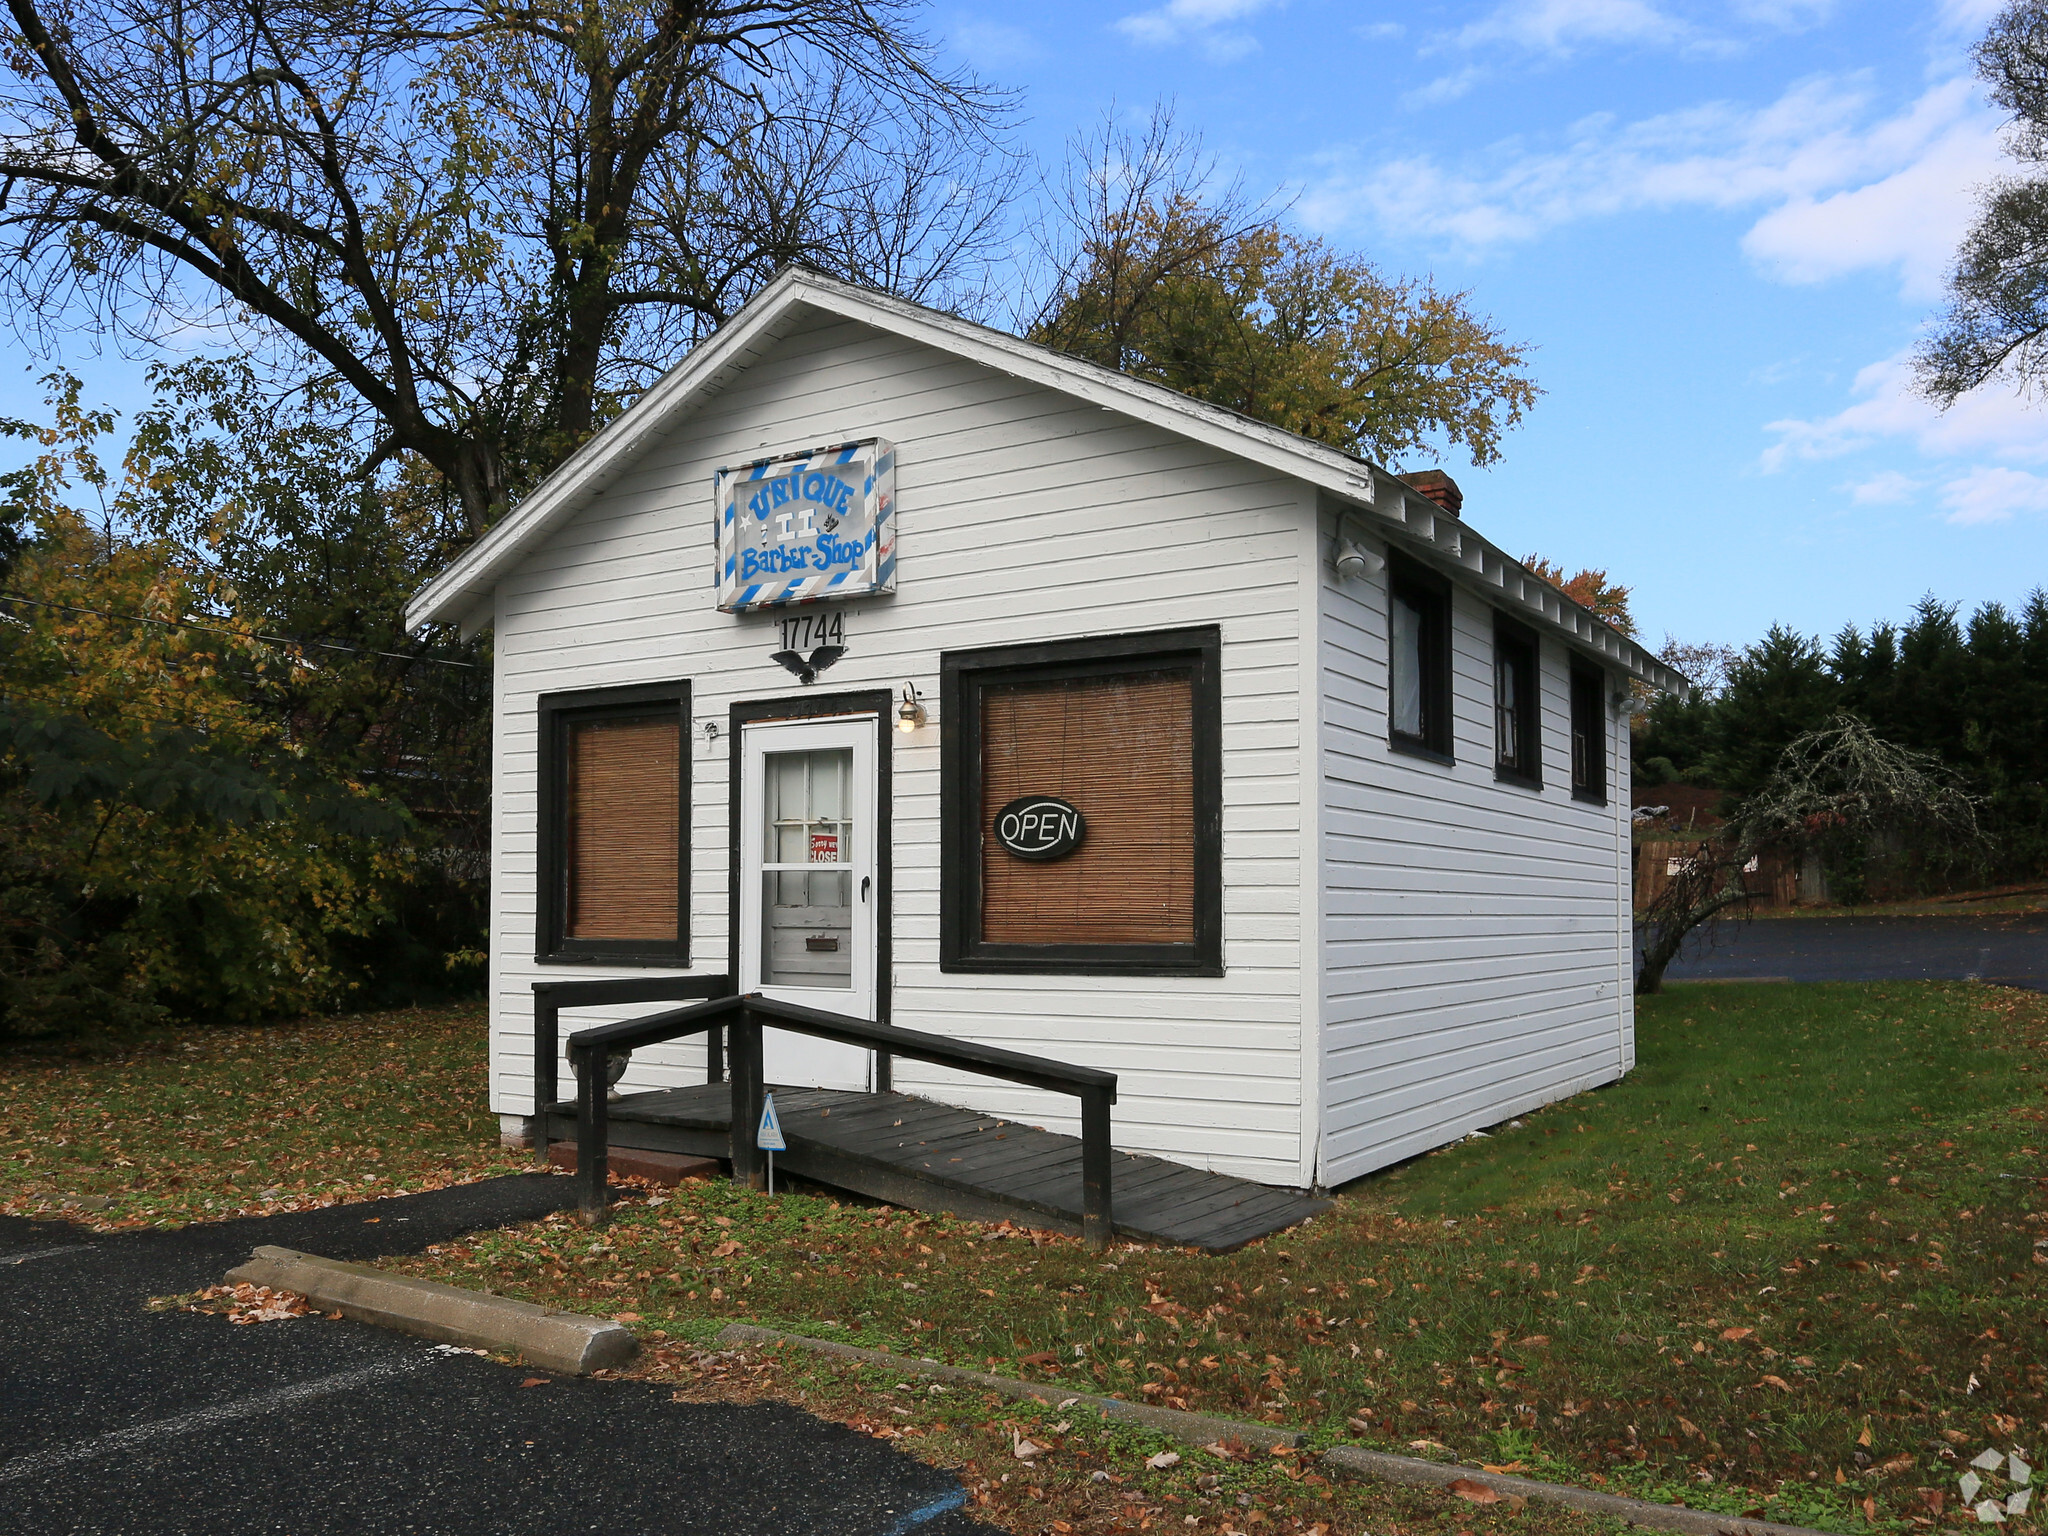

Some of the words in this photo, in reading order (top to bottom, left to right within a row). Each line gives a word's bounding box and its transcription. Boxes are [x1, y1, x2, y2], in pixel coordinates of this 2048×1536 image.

[748, 472, 855, 522] UNIQUE
[775, 508, 820, 542] II
[741, 533, 864, 581] Barber-Shop
[781, 611, 843, 650] 17744
[1001, 813, 1078, 841] OPEN
[811, 850, 838, 863] CLOSE
